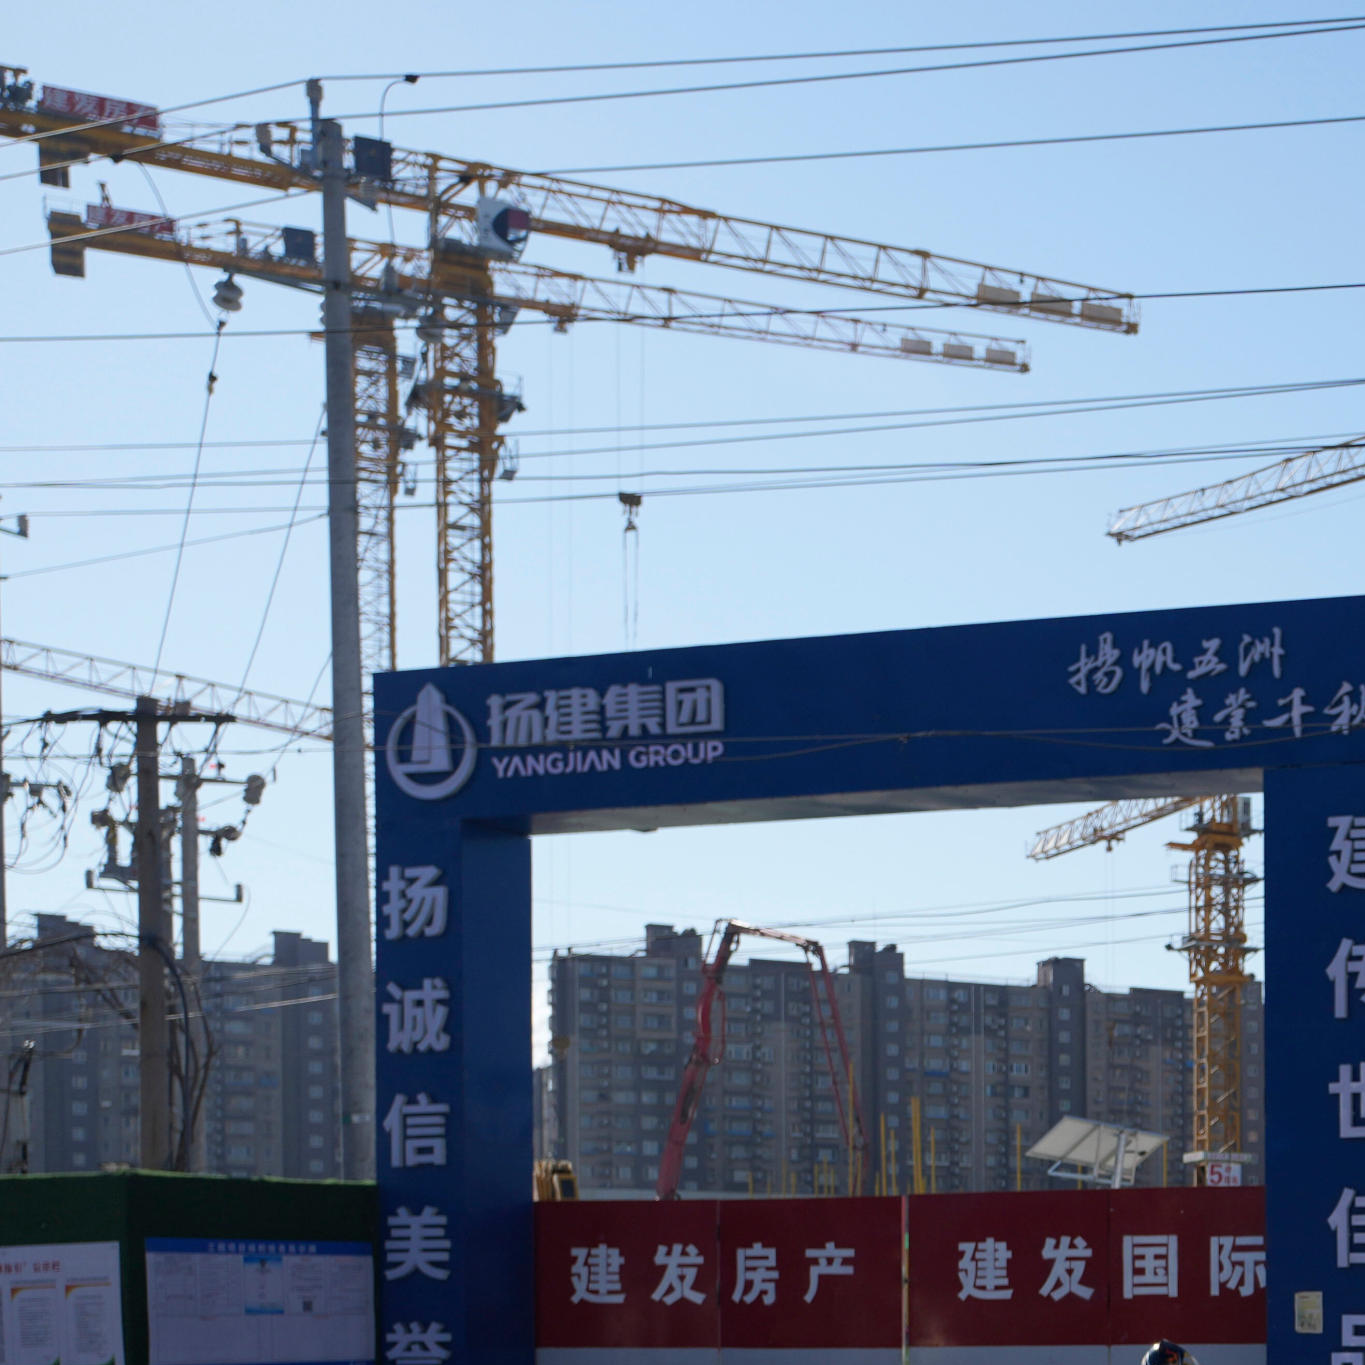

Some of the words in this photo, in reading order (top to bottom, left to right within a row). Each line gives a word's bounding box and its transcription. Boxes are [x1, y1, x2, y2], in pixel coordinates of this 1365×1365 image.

[486, 678, 725, 746] 扬建集团
[491, 747, 622, 778] YANGJIAN
[629, 740, 725, 767] GROUP
[570, 1241, 857, 1306] 建发房产
[957, 1234, 1266, 1302] 建发国际
